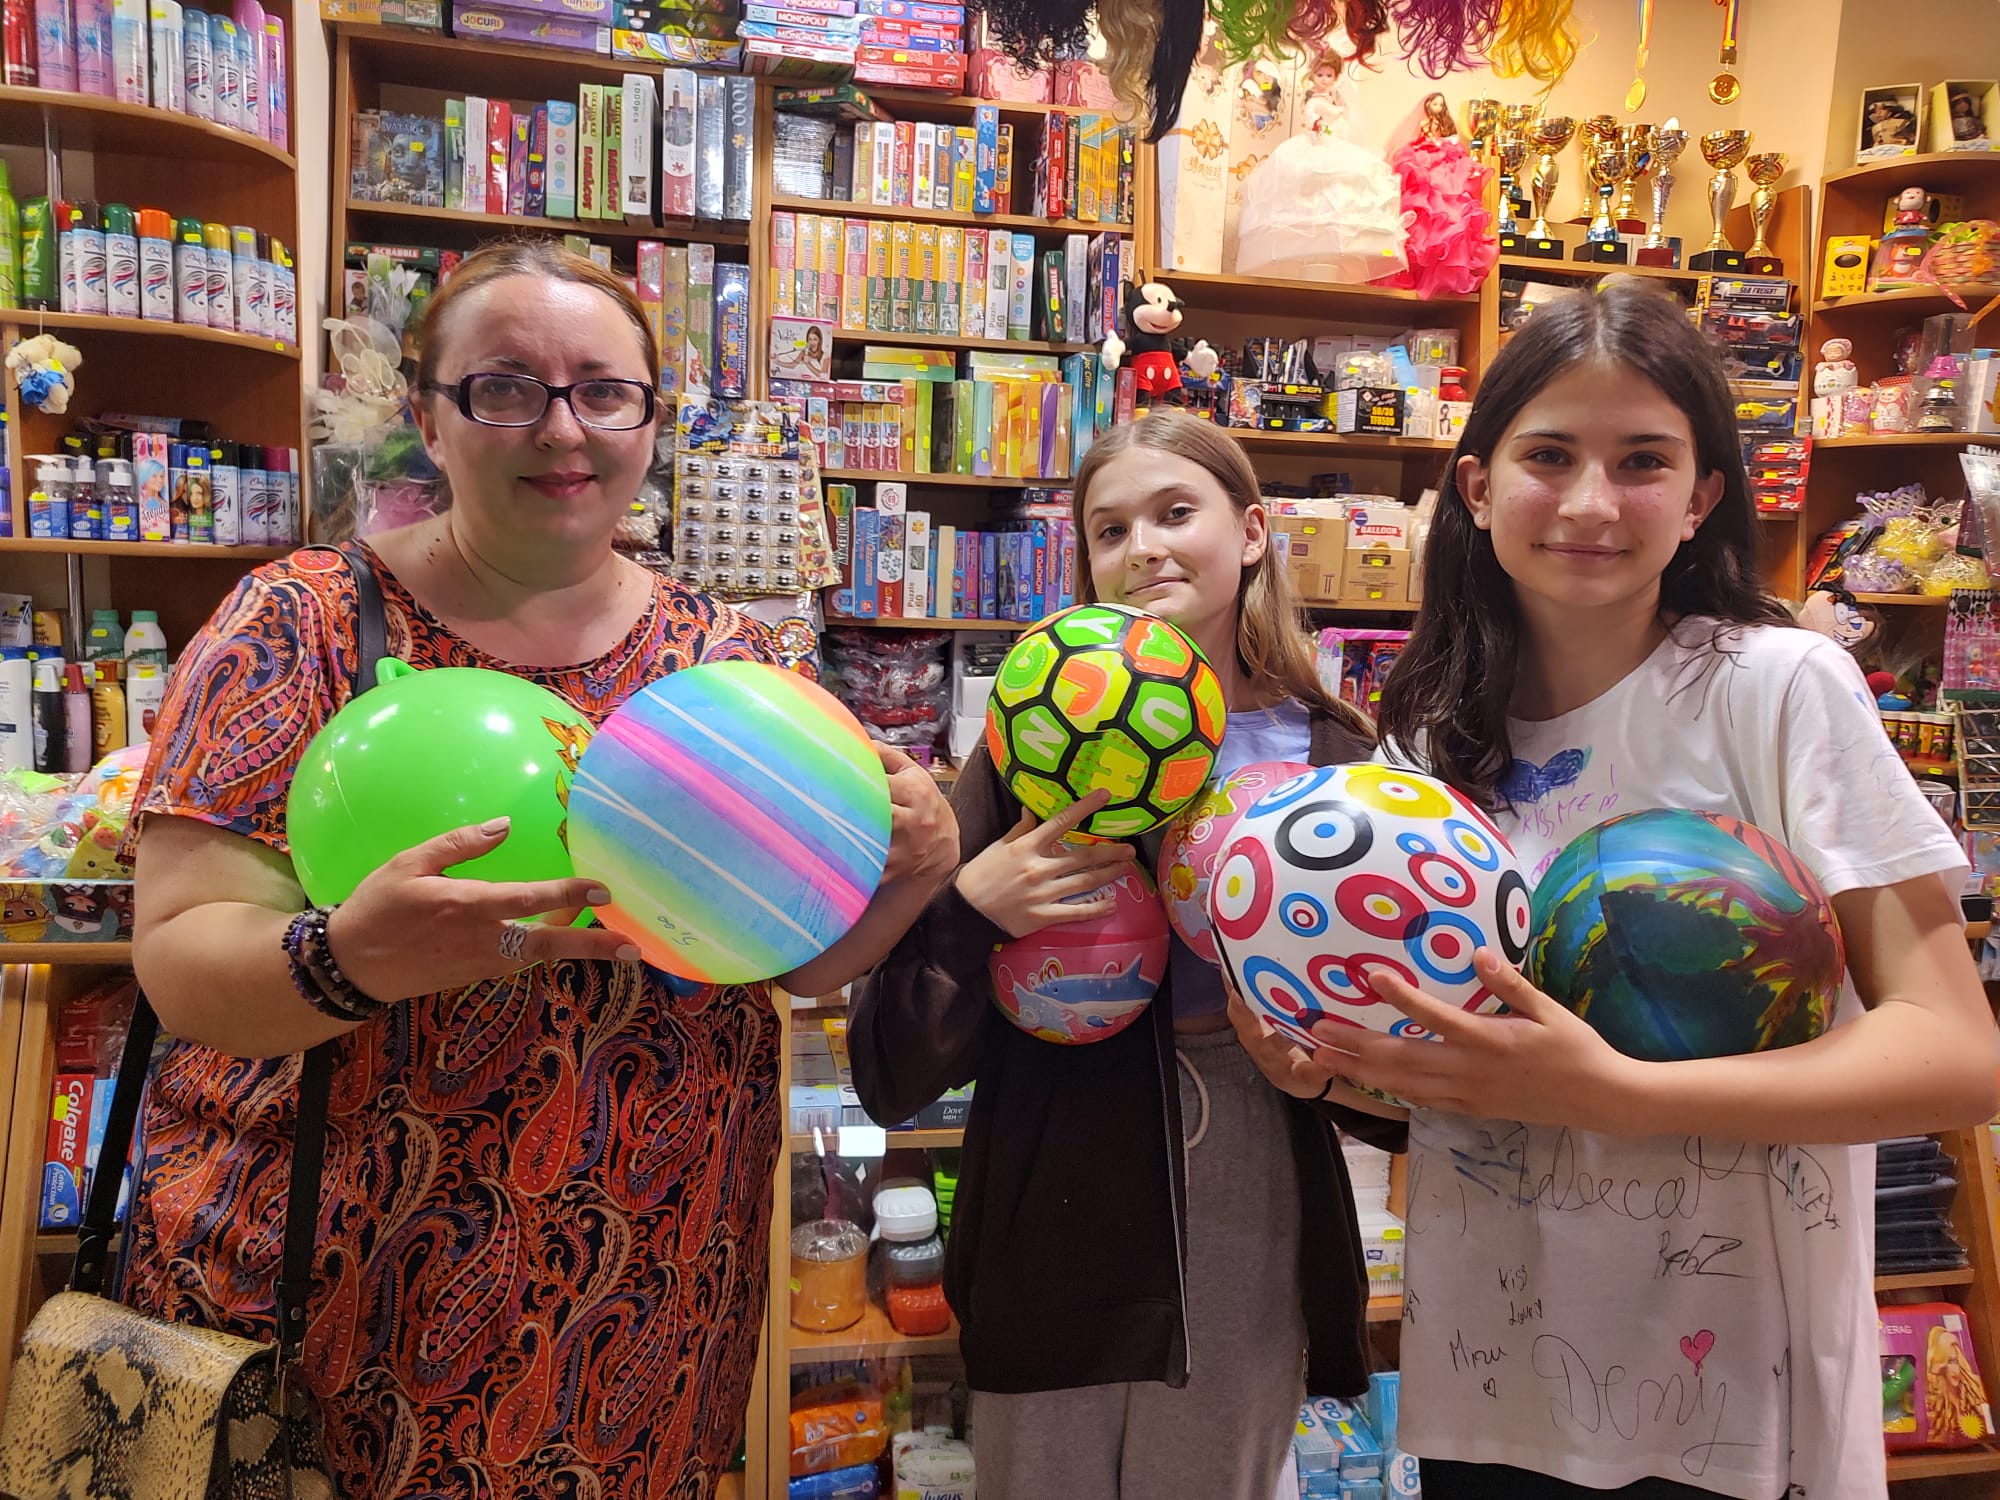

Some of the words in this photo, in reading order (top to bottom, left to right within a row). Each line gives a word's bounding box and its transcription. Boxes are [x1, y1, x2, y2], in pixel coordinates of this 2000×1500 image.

[463, 15, 500, 27] JOCURI
[777, 11, 828, 26] MONOPOLY
[776, 29, 827, 41] MONOPOLY
[799, 89, 835, 98] SCRABBLE
[731, 82, 748, 127] 1000
[988, 301, 997, 328] Puzzle
[996, 315, 1006, 328] 60
[1360, 526, 1398, 535] BALLOON
[836, 515, 849, 565] AFACERILOR
[1035, 549, 1044, 594] MONOPOLY
[1063, 549, 1072, 594] MONOPOLY
[943, 1106, 962, 1115] Dove
[59, 1079, 85, 1162] Colgate
